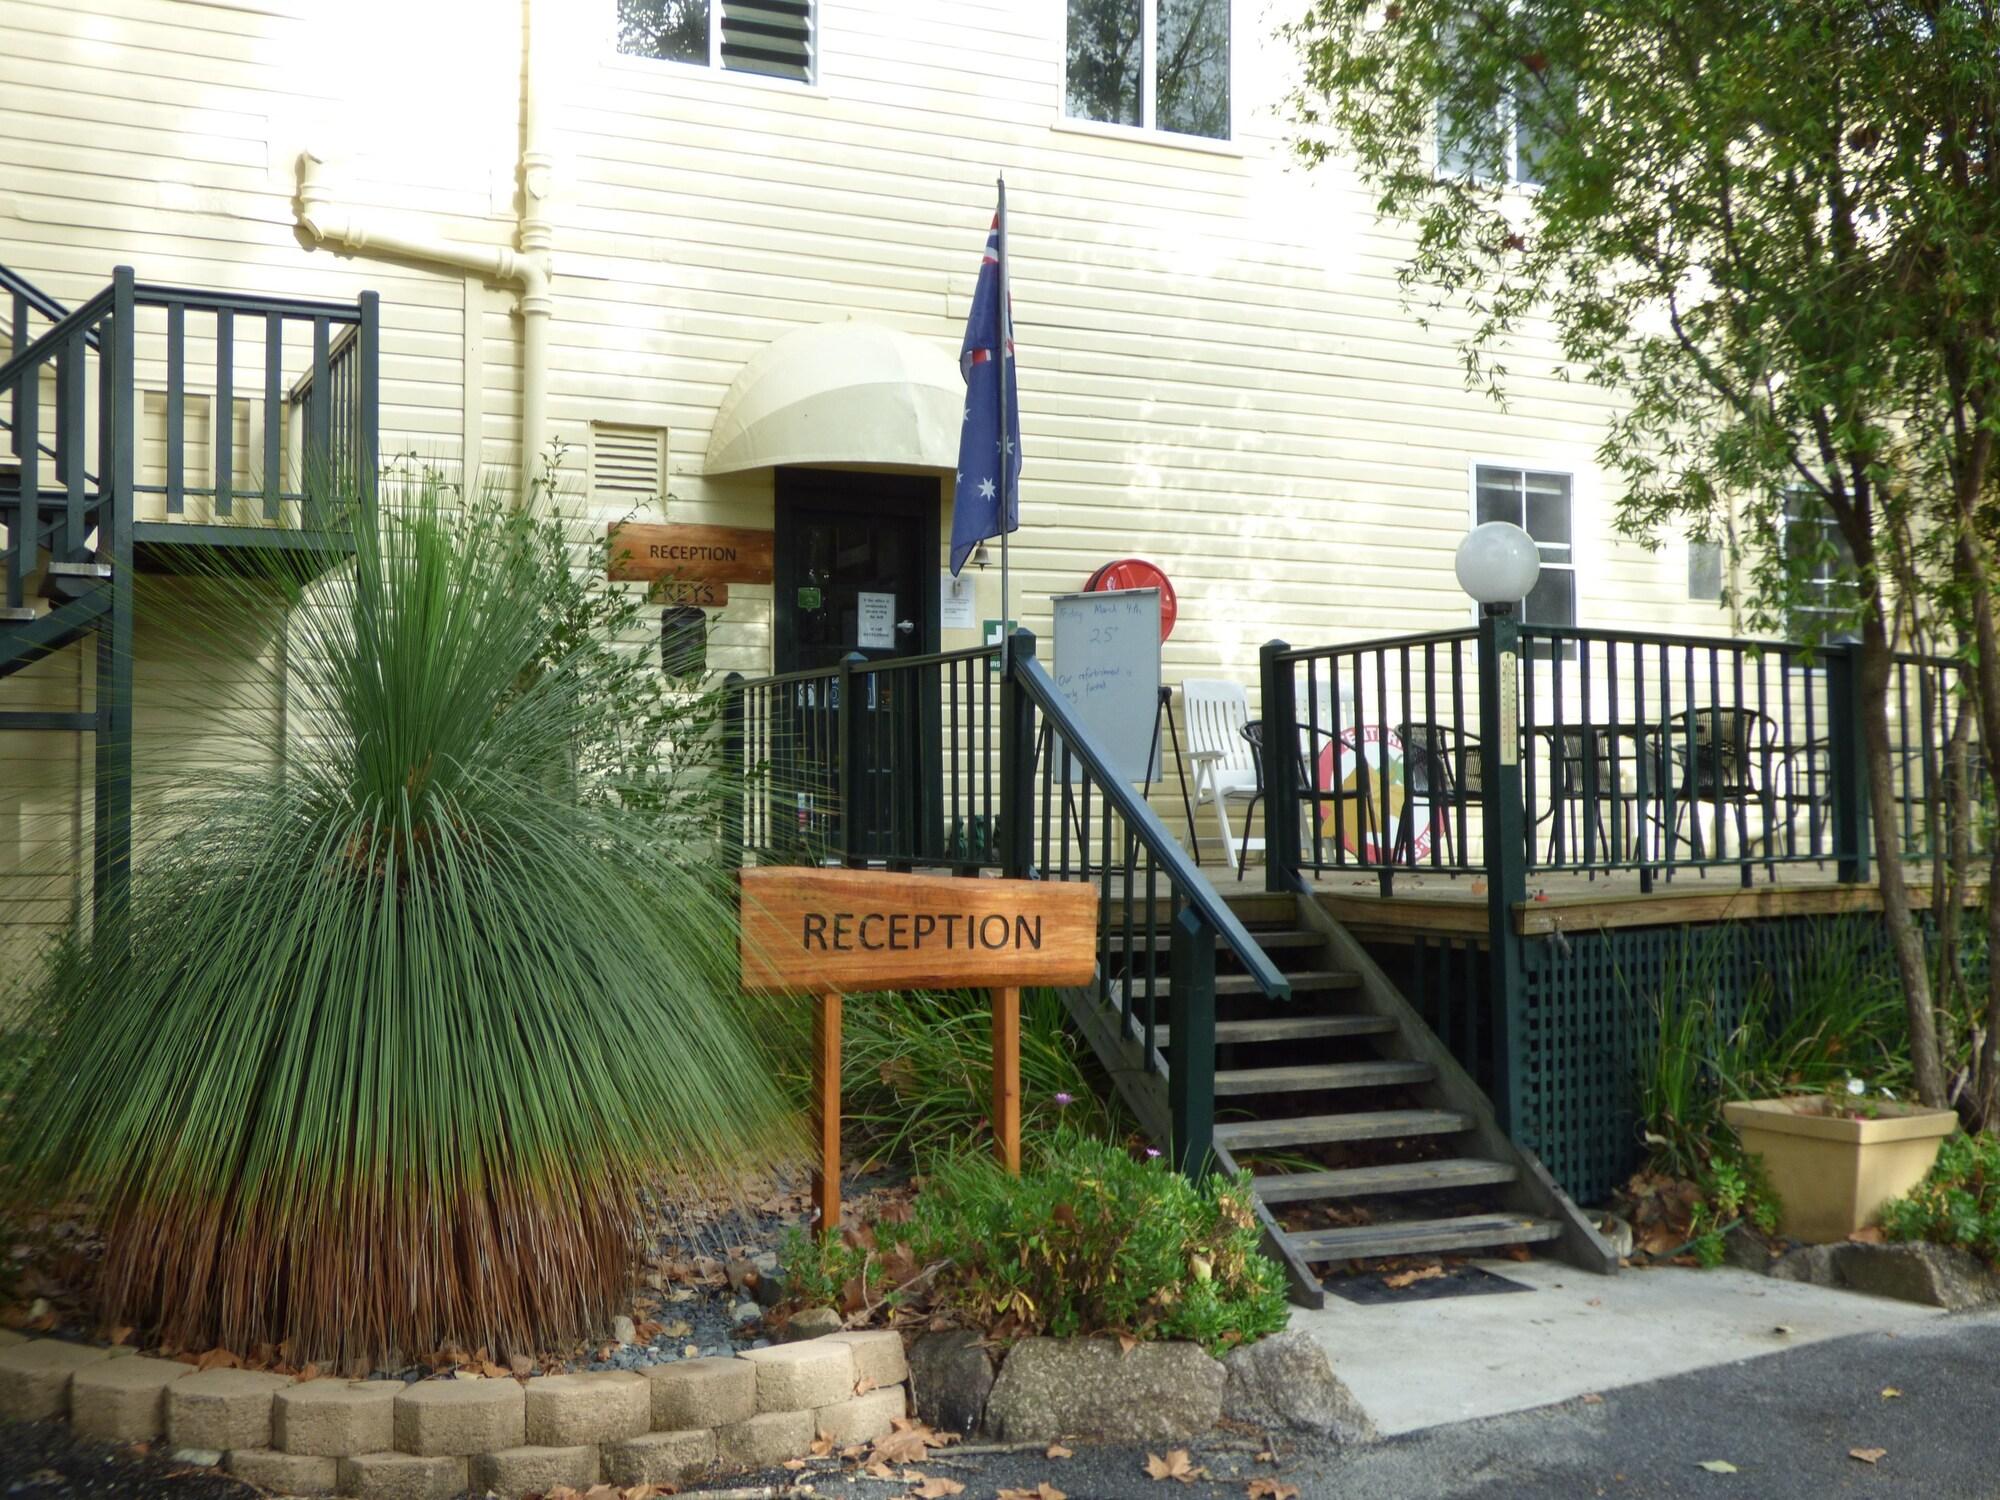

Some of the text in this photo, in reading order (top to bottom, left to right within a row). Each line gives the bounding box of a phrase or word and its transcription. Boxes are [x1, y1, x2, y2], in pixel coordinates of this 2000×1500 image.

[649, 544, 737, 561] RECEPTION
[663, 583, 714, 603] KEYS
[803, 913, 1042, 951] RECEPTION
